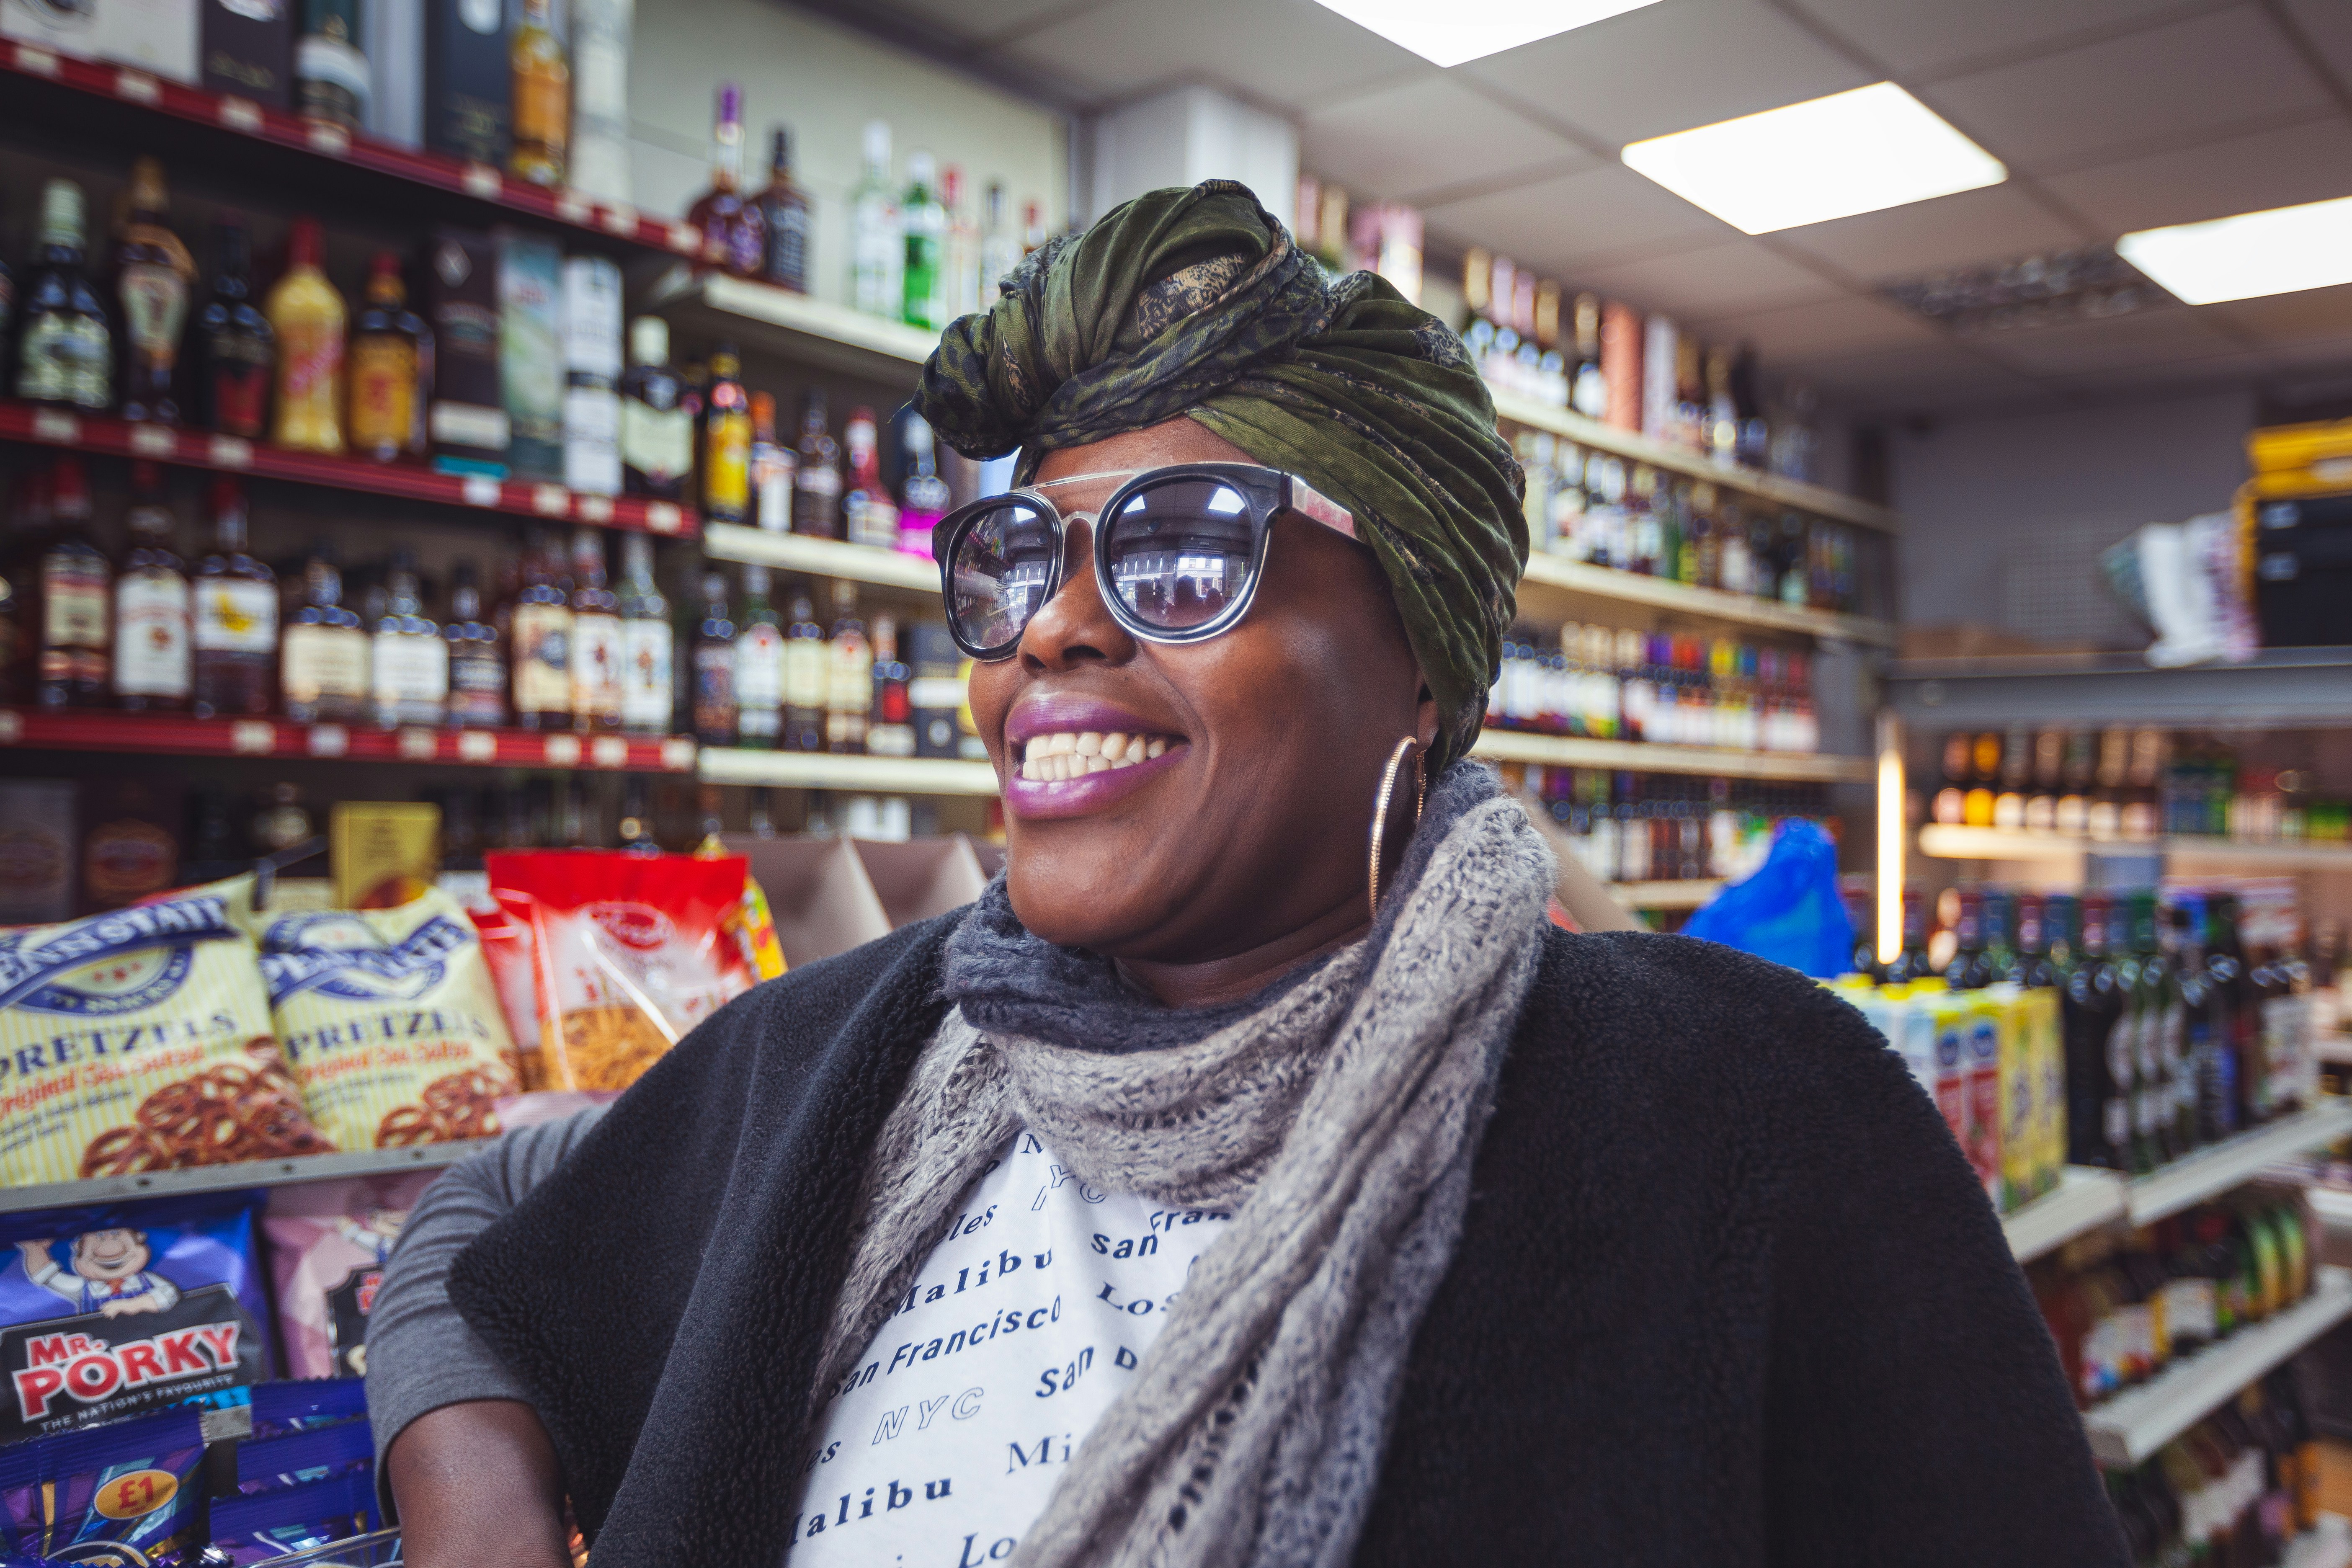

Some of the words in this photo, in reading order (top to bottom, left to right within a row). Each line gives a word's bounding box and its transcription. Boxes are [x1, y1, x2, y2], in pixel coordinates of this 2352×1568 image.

[0, 1065, 77, 1122] riginal
[887, 1294, 1061, 1375] Francisco
[13, 1320, 242, 1423] PORKY
[1035, 1345, 1094, 1398] San
[41, 1414, 73, 1433] THE
[77, 1390, 152, 1421] NATION'S
[157, 1372, 235, 1400] FAVOURITE
[872, 1387, 984, 1446] NYC
[118, 1475, 154, 1510] £1
